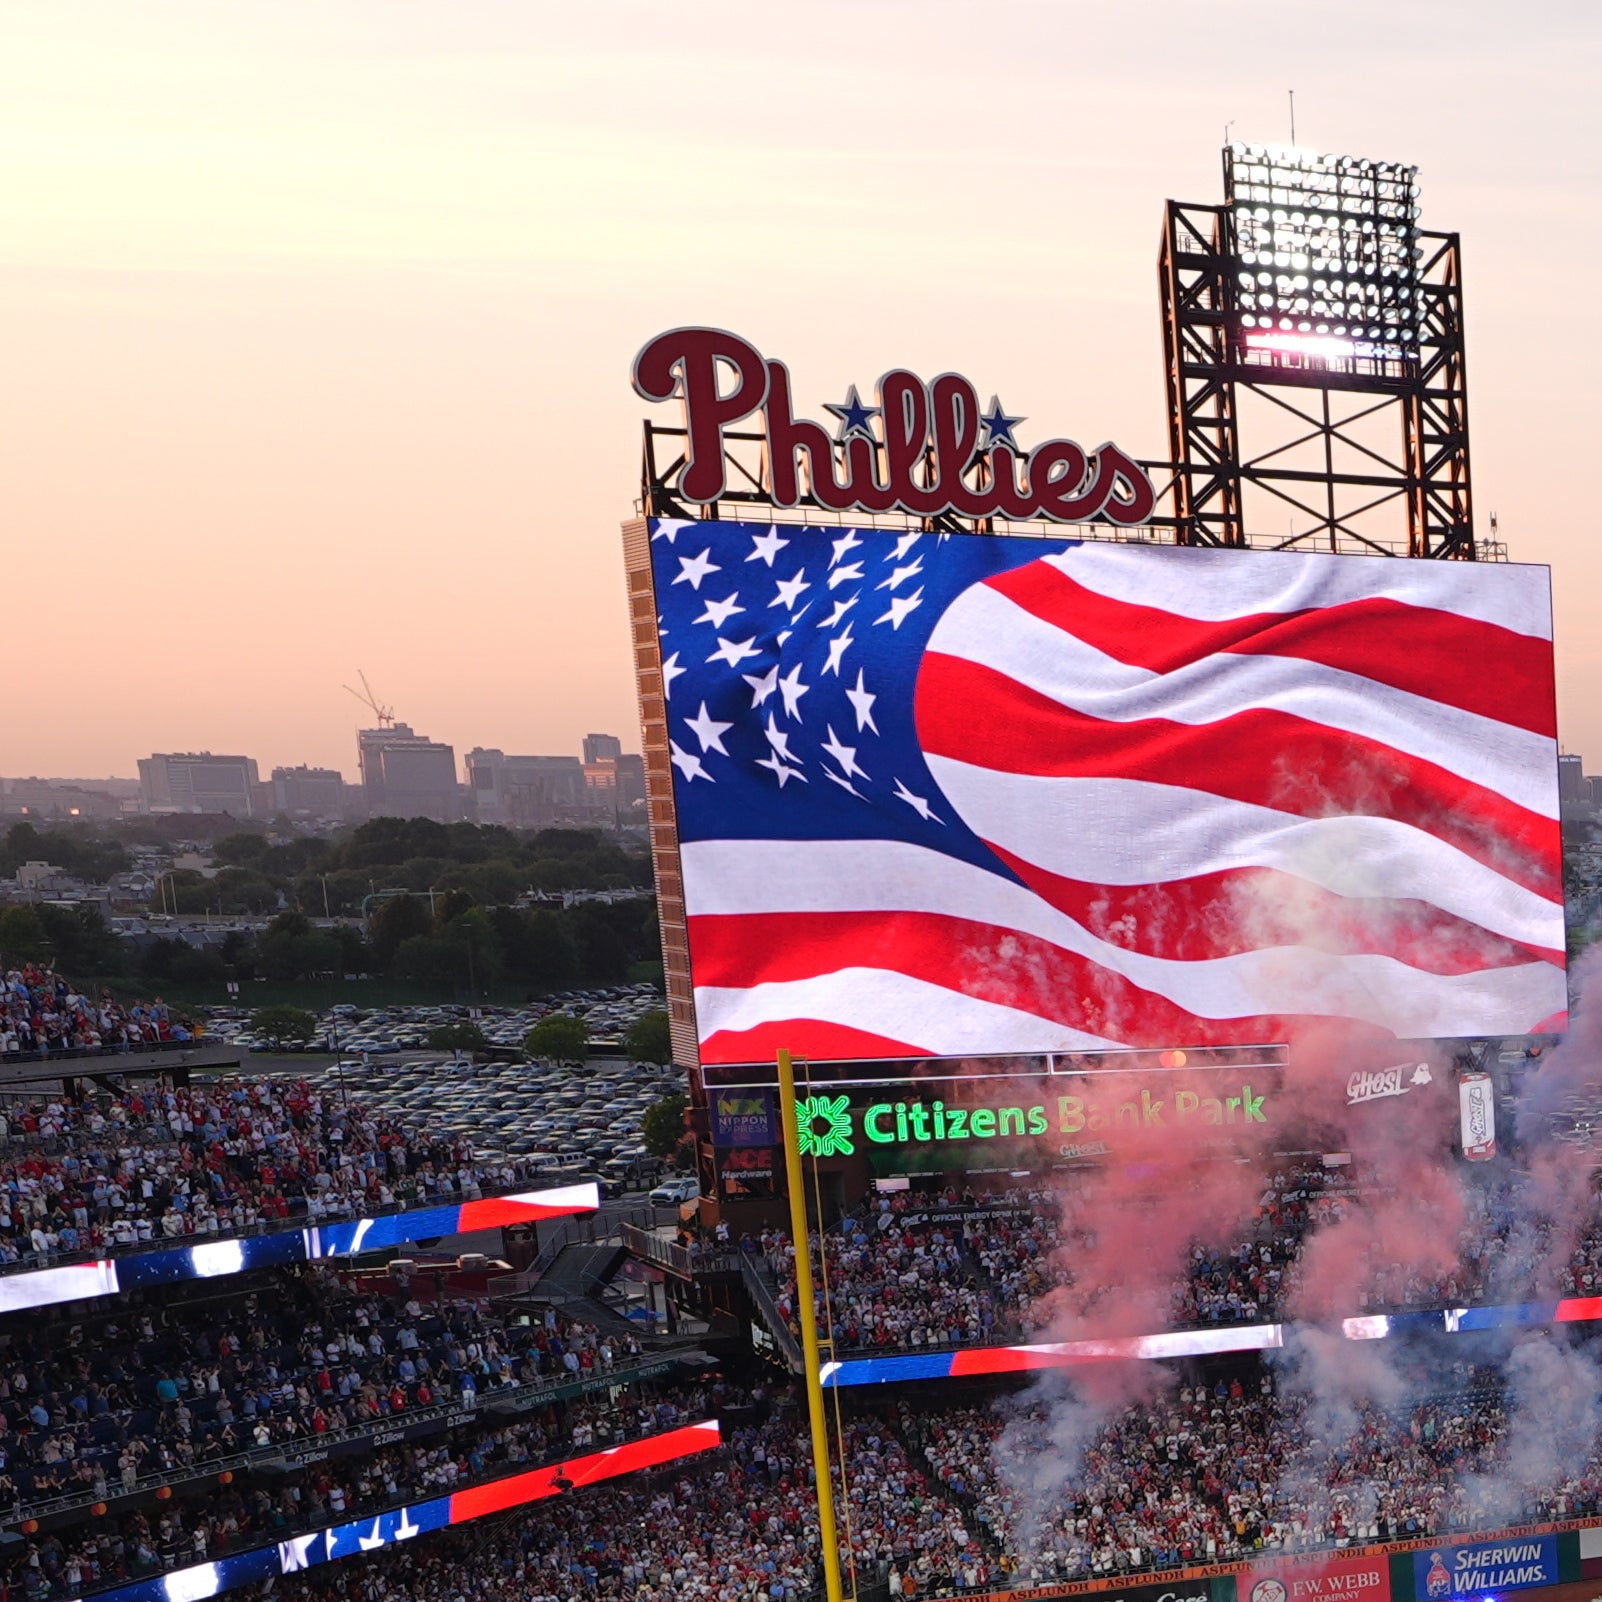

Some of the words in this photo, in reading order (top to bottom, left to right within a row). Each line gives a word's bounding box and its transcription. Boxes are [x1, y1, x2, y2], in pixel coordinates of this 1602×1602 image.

[631, 326, 1157, 527] Phillies
[1347, 1062, 1415, 1105] GHOST
[717, 1099, 766, 1116] NX
[864, 1101, 1049, 1143] Citizens
[1057, 1090, 1168, 1133] Bank
[1175, 1086, 1267, 1126] Park
[718, 1115, 768, 1126] NIPPON
[718, 1124, 768, 1135] EXPRESS
[722, 1149, 772, 1169] ACE
[721, 1168, 772, 1179] Hardware
[932, 1213, 962, 1223] OFFICIAL
[522, 1391, 557, 1406] NUTRAFOL
[455, 1413, 477, 1427] Zillow
[381, 1431, 406, 1445] Zillow
[303, 1450, 329, 1464] Zillow
[1467, 1526, 1538, 1544] ASPLUNDH
[1381, 1536, 1453, 1553] ASPLUNDH
[1292, 1546, 1366, 1565] ASPLUNDH
[1454, 1543, 1542, 1571] SHERWIN
[1200, 1558, 1278, 1577] ASPLUNDH
[1105, 1570, 1185, 1588] ASPLUNDH
[1293, 1577, 1324, 1596] F.W.
[1328, 1571, 1381, 1590] WEBB
[1007, 1582, 1090, 1602] ASPLUNDH
